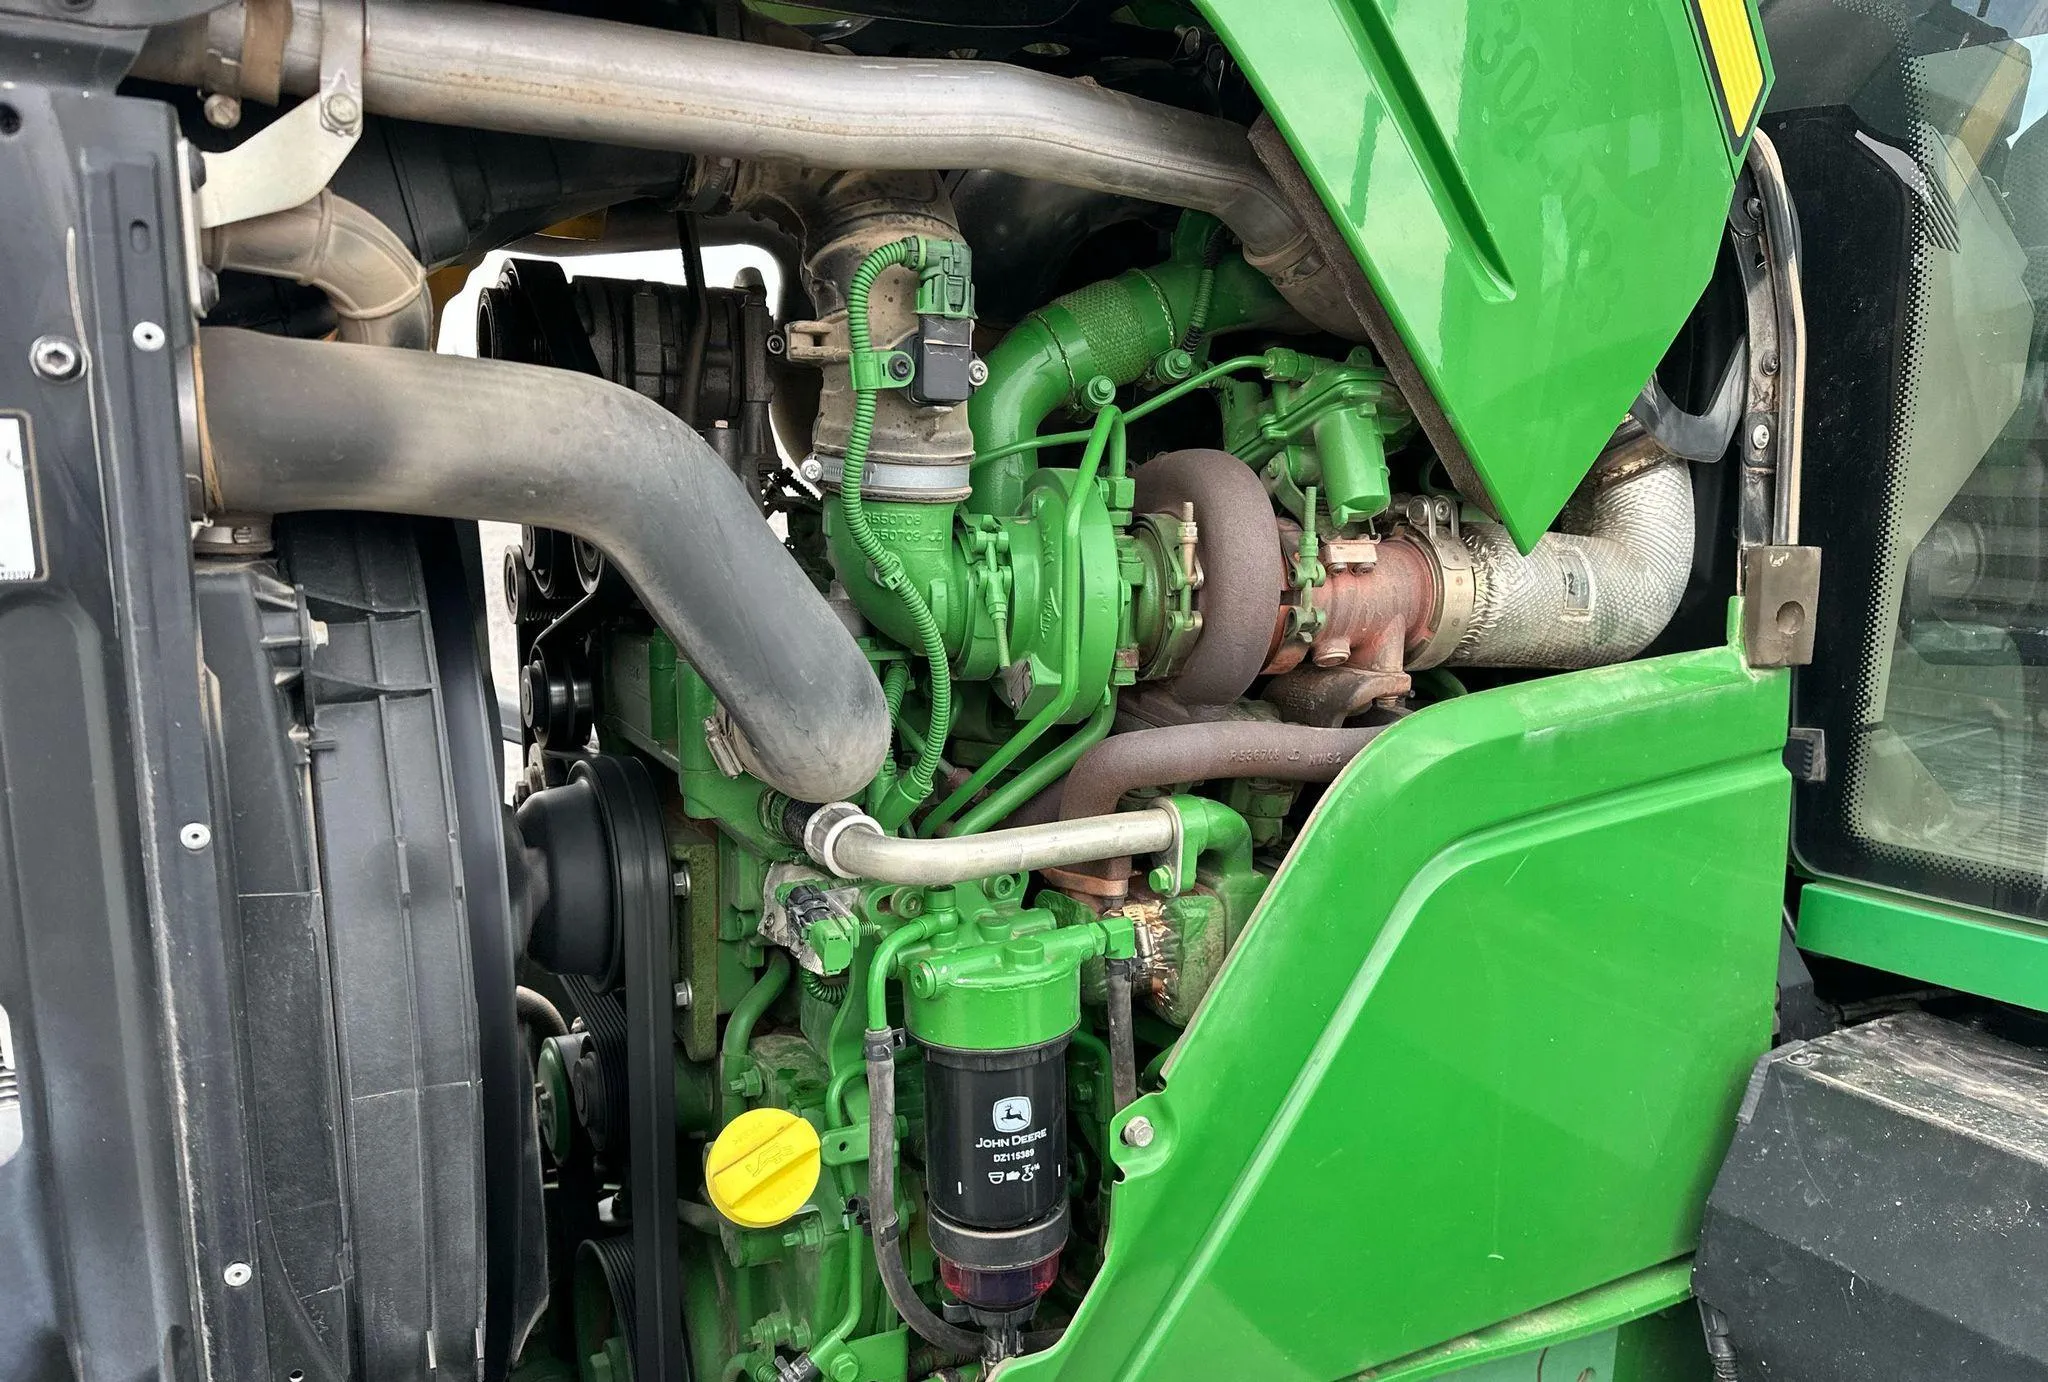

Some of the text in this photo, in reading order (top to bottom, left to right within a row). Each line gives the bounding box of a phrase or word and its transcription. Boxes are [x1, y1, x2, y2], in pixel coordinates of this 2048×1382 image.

[975, 1128, 1047, 1149] JOHN DEERE
[993, 1148, 1035, 1162] DZ115389
